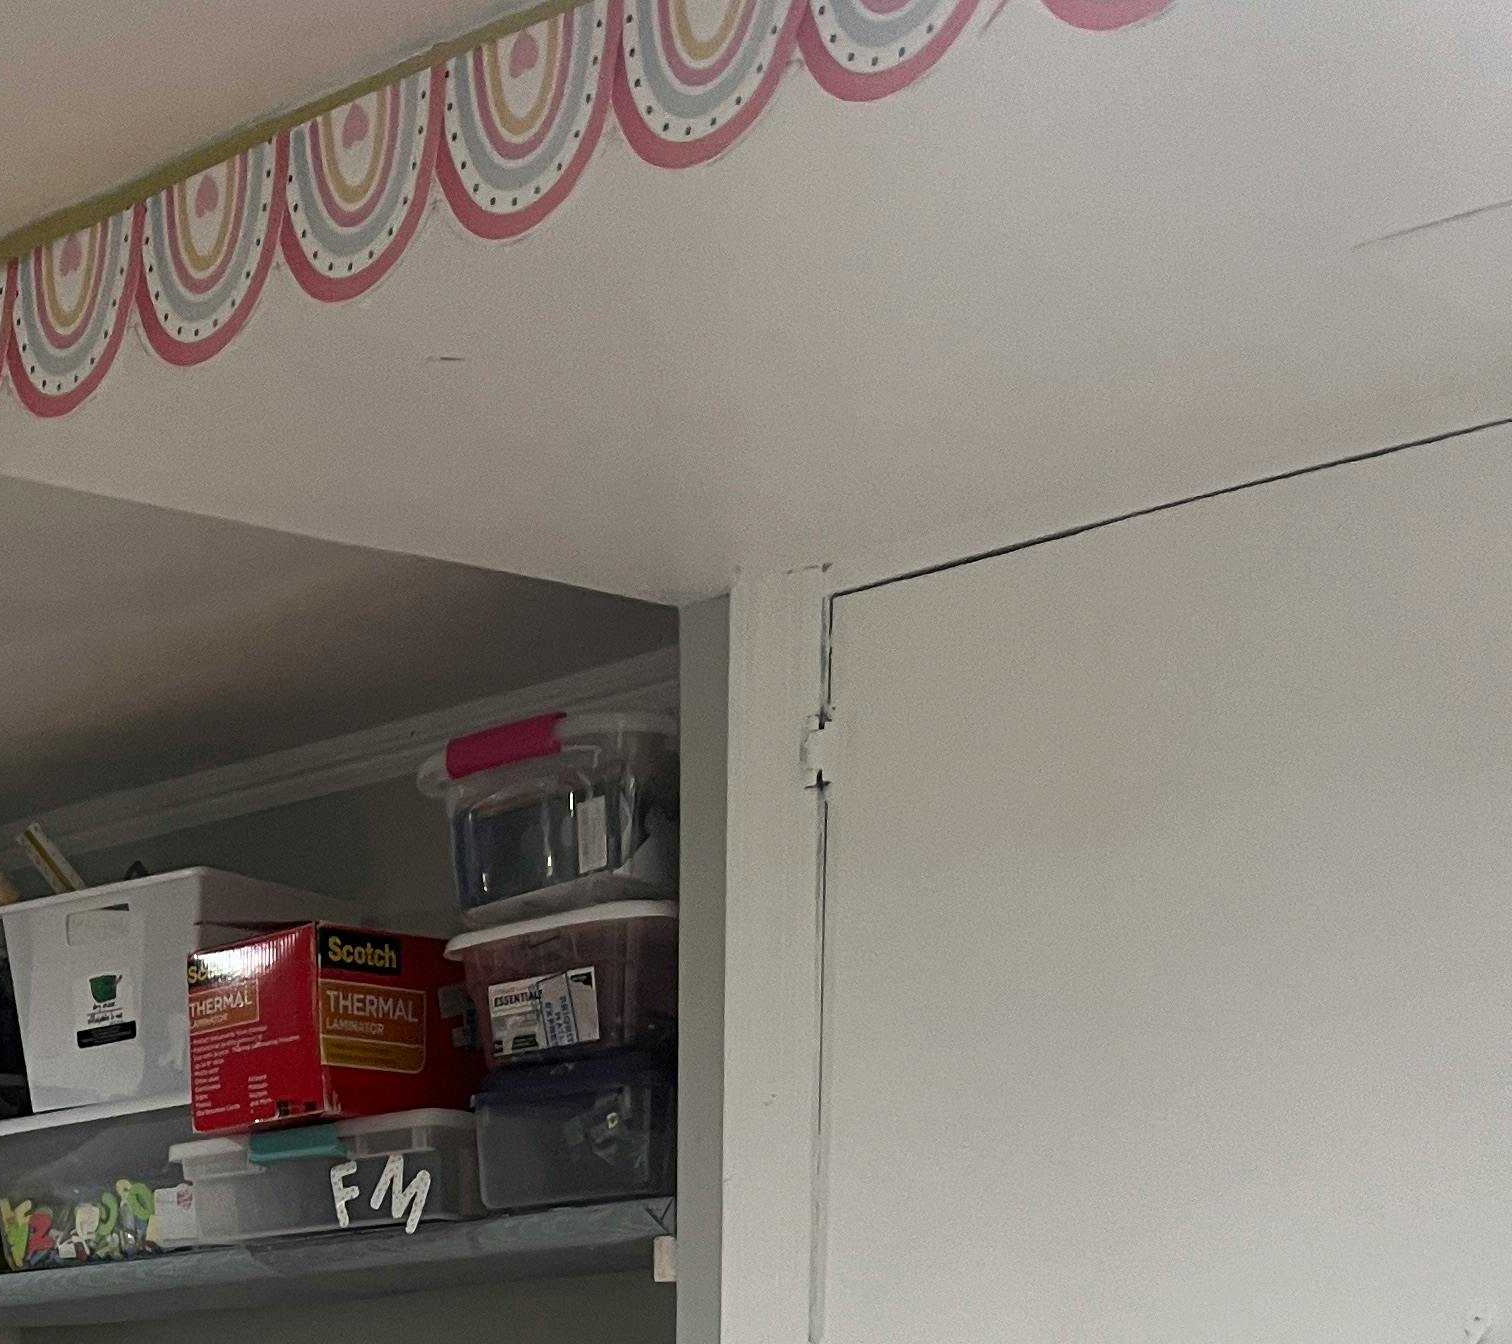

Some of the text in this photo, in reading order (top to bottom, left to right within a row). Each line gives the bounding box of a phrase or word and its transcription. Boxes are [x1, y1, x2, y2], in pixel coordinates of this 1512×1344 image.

[327, 935, 398, 969] Scotch
[188, 989, 253, 1017] THERMAL
[326, 990, 419, 1023] THERMAL
[325, 1018, 386, 1035] LAMINATOR
